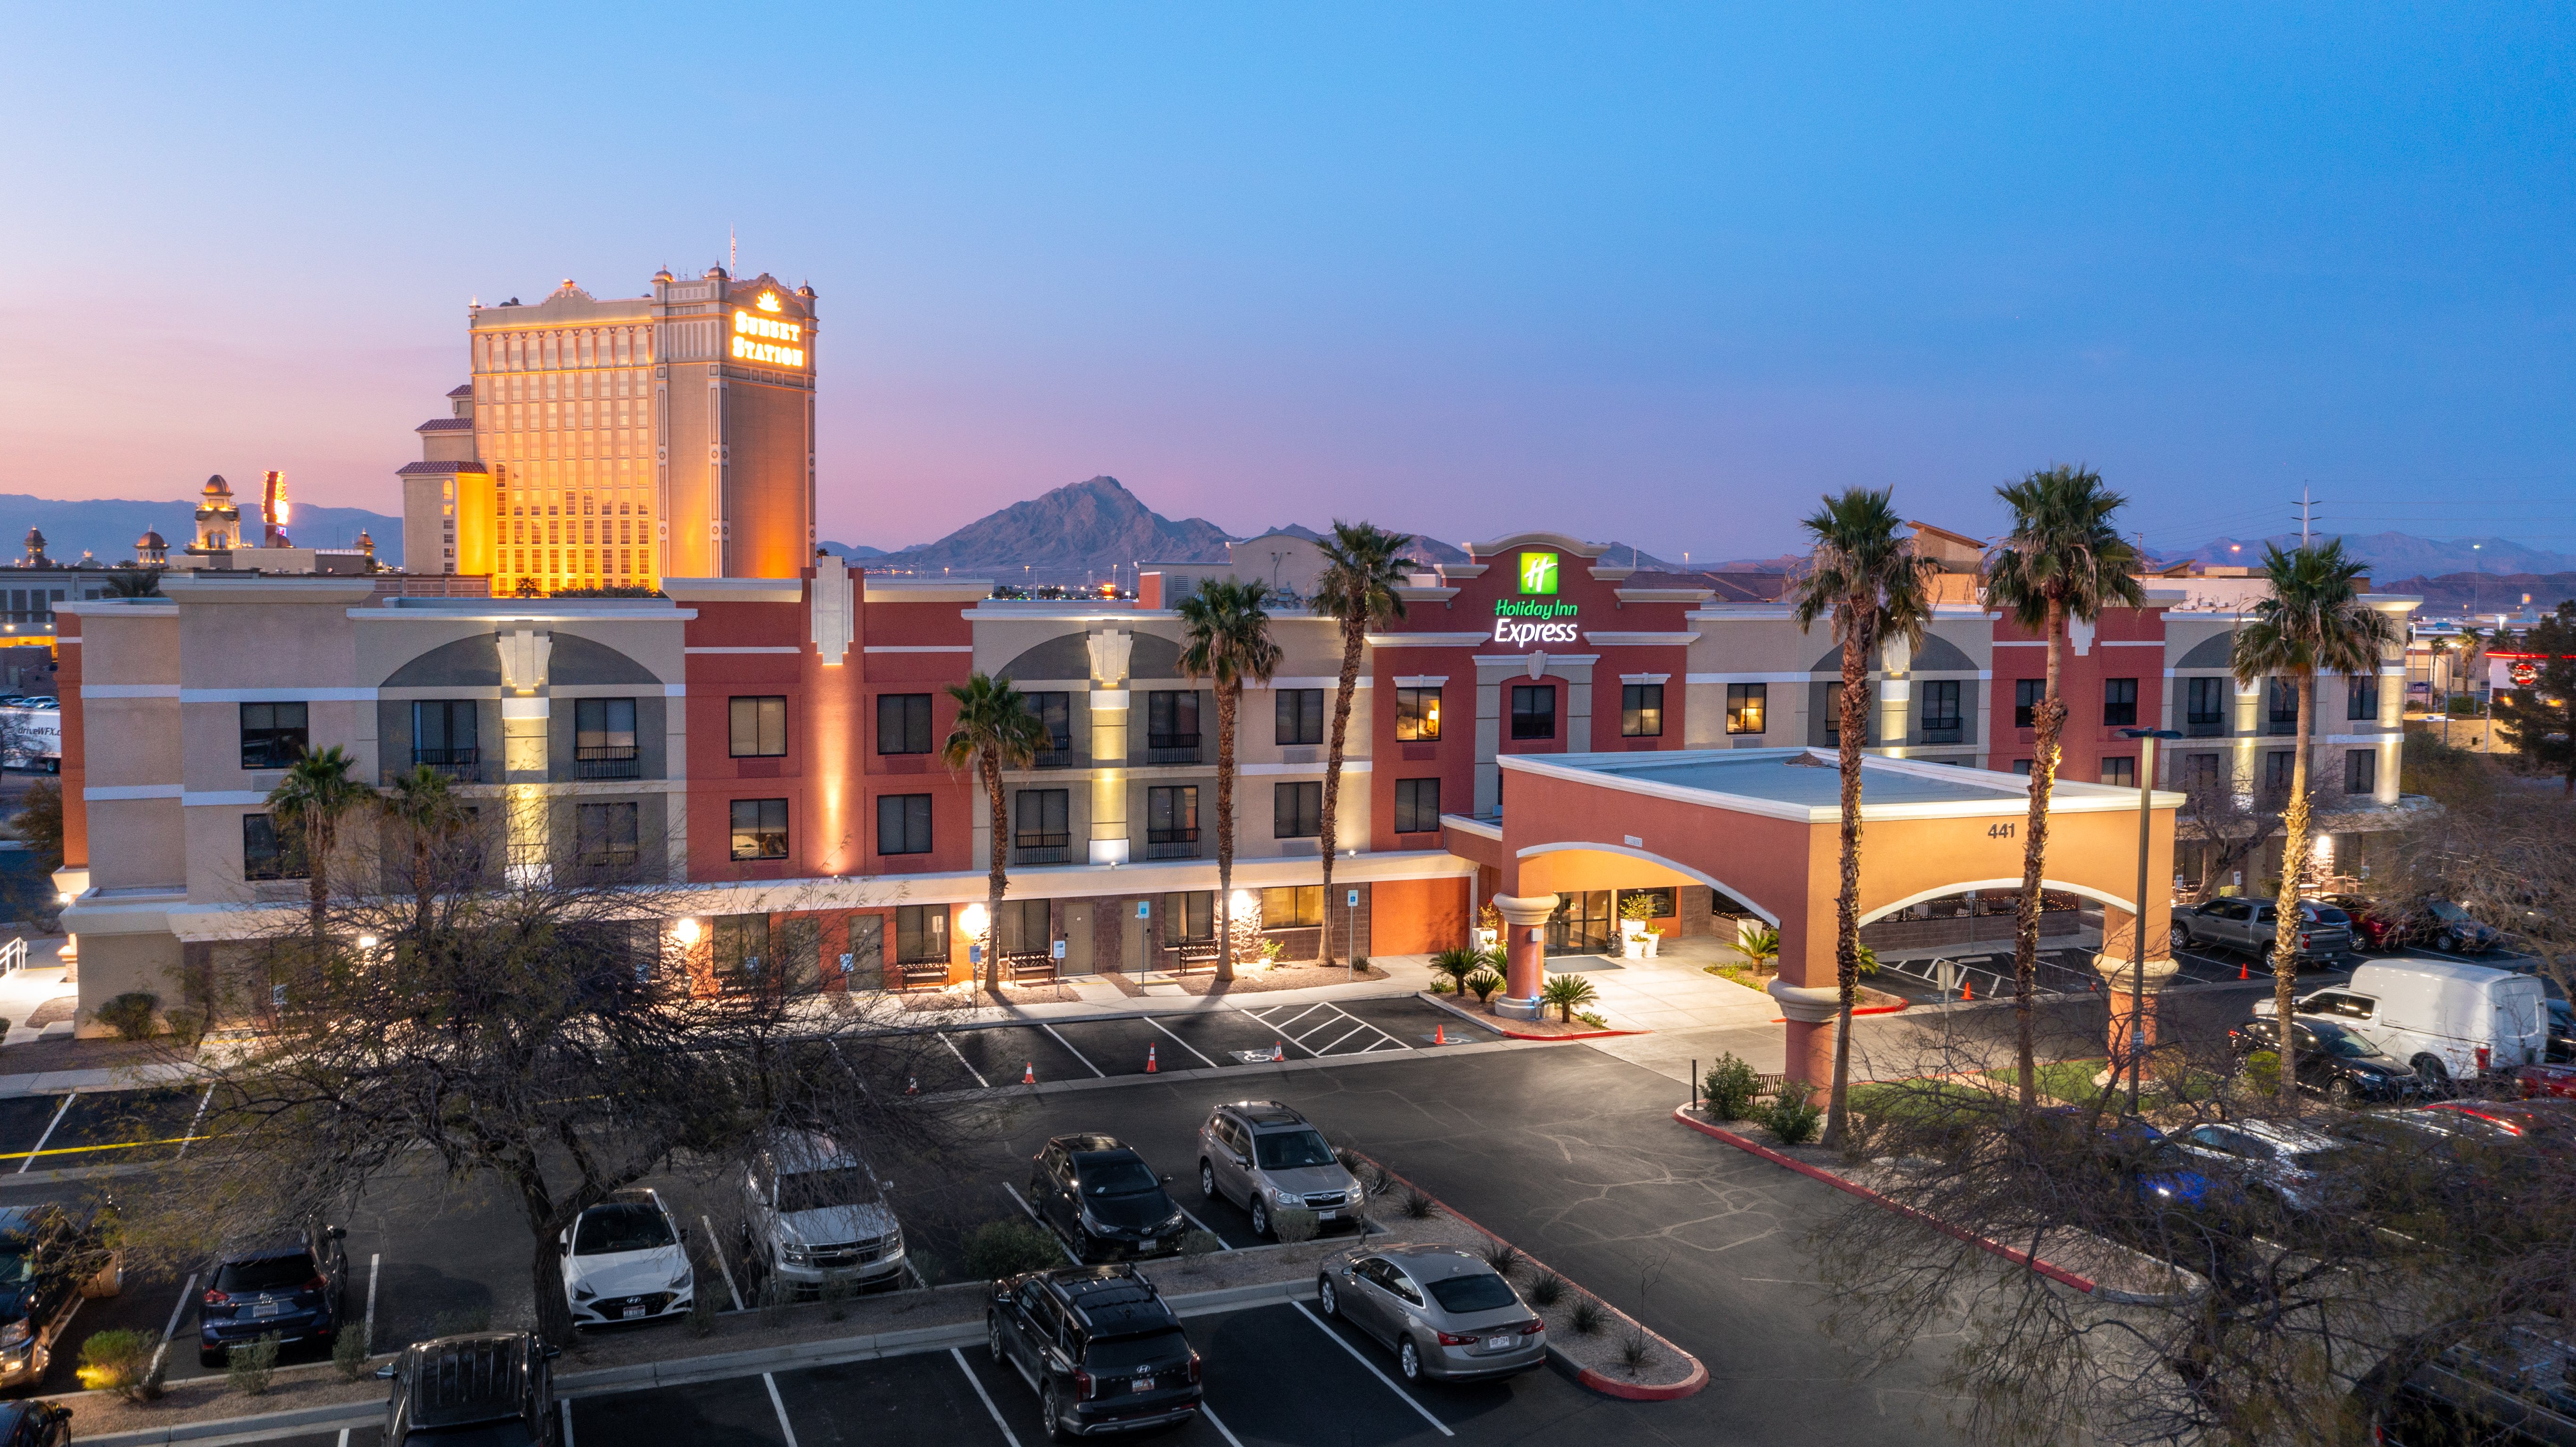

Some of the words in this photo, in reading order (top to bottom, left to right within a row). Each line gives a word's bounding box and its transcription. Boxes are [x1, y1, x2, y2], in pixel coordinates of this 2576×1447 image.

[735, 311, 800, 341] SUNSET
[733, 336, 803, 366] STATION
[1494, 599, 1553, 620] Holiday
[1555, 599, 1578, 616] Inn
[1494, 618, 1577, 648] Express
[1988, 822, 2015, 839] 441
